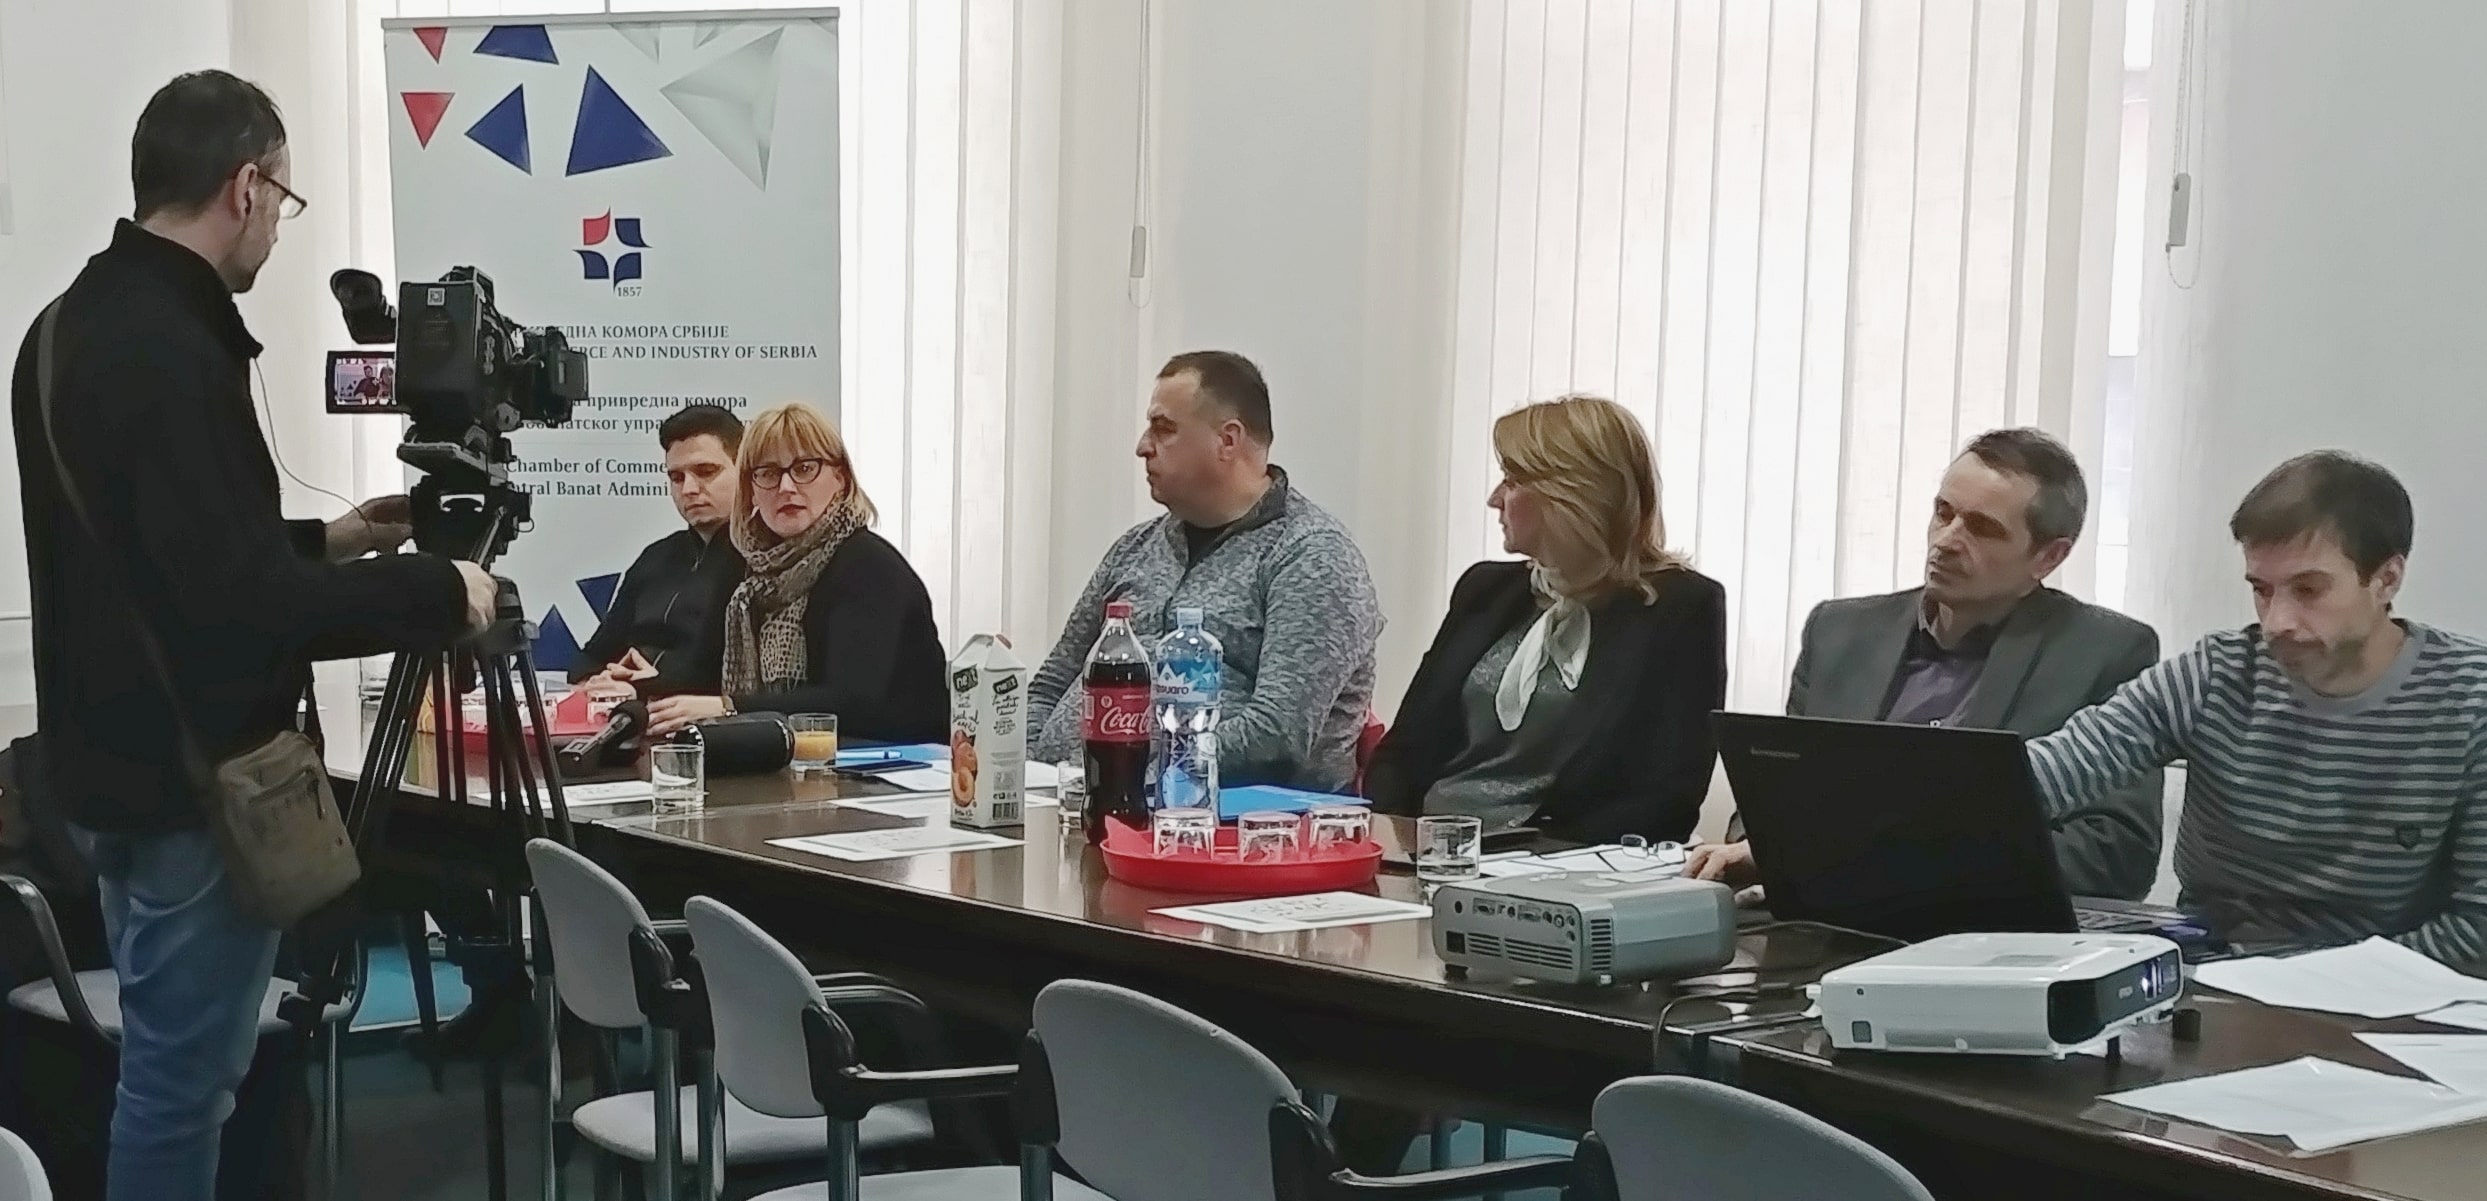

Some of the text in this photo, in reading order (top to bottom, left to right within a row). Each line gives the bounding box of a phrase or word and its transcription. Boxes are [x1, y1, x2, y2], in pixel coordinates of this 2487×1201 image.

[616, 286, 642, 297] 1857
[602, 325, 668, 338] КОМОРА
[672, 325, 729, 338] СРБИЈЕ
[612, 346, 646, 359] AND
[651, 346, 730, 359] INDUSTRY
[735, 346, 755, 359] OF
[760, 345, 818, 359] SERBIA
[587, 396, 679, 411] привредна
[685, 396, 747, 412] комора
[506, 458, 667, 474] Chamber of Comme
[557, 481, 601, 496] Banat
[607, 481, 668, 496] Admini
